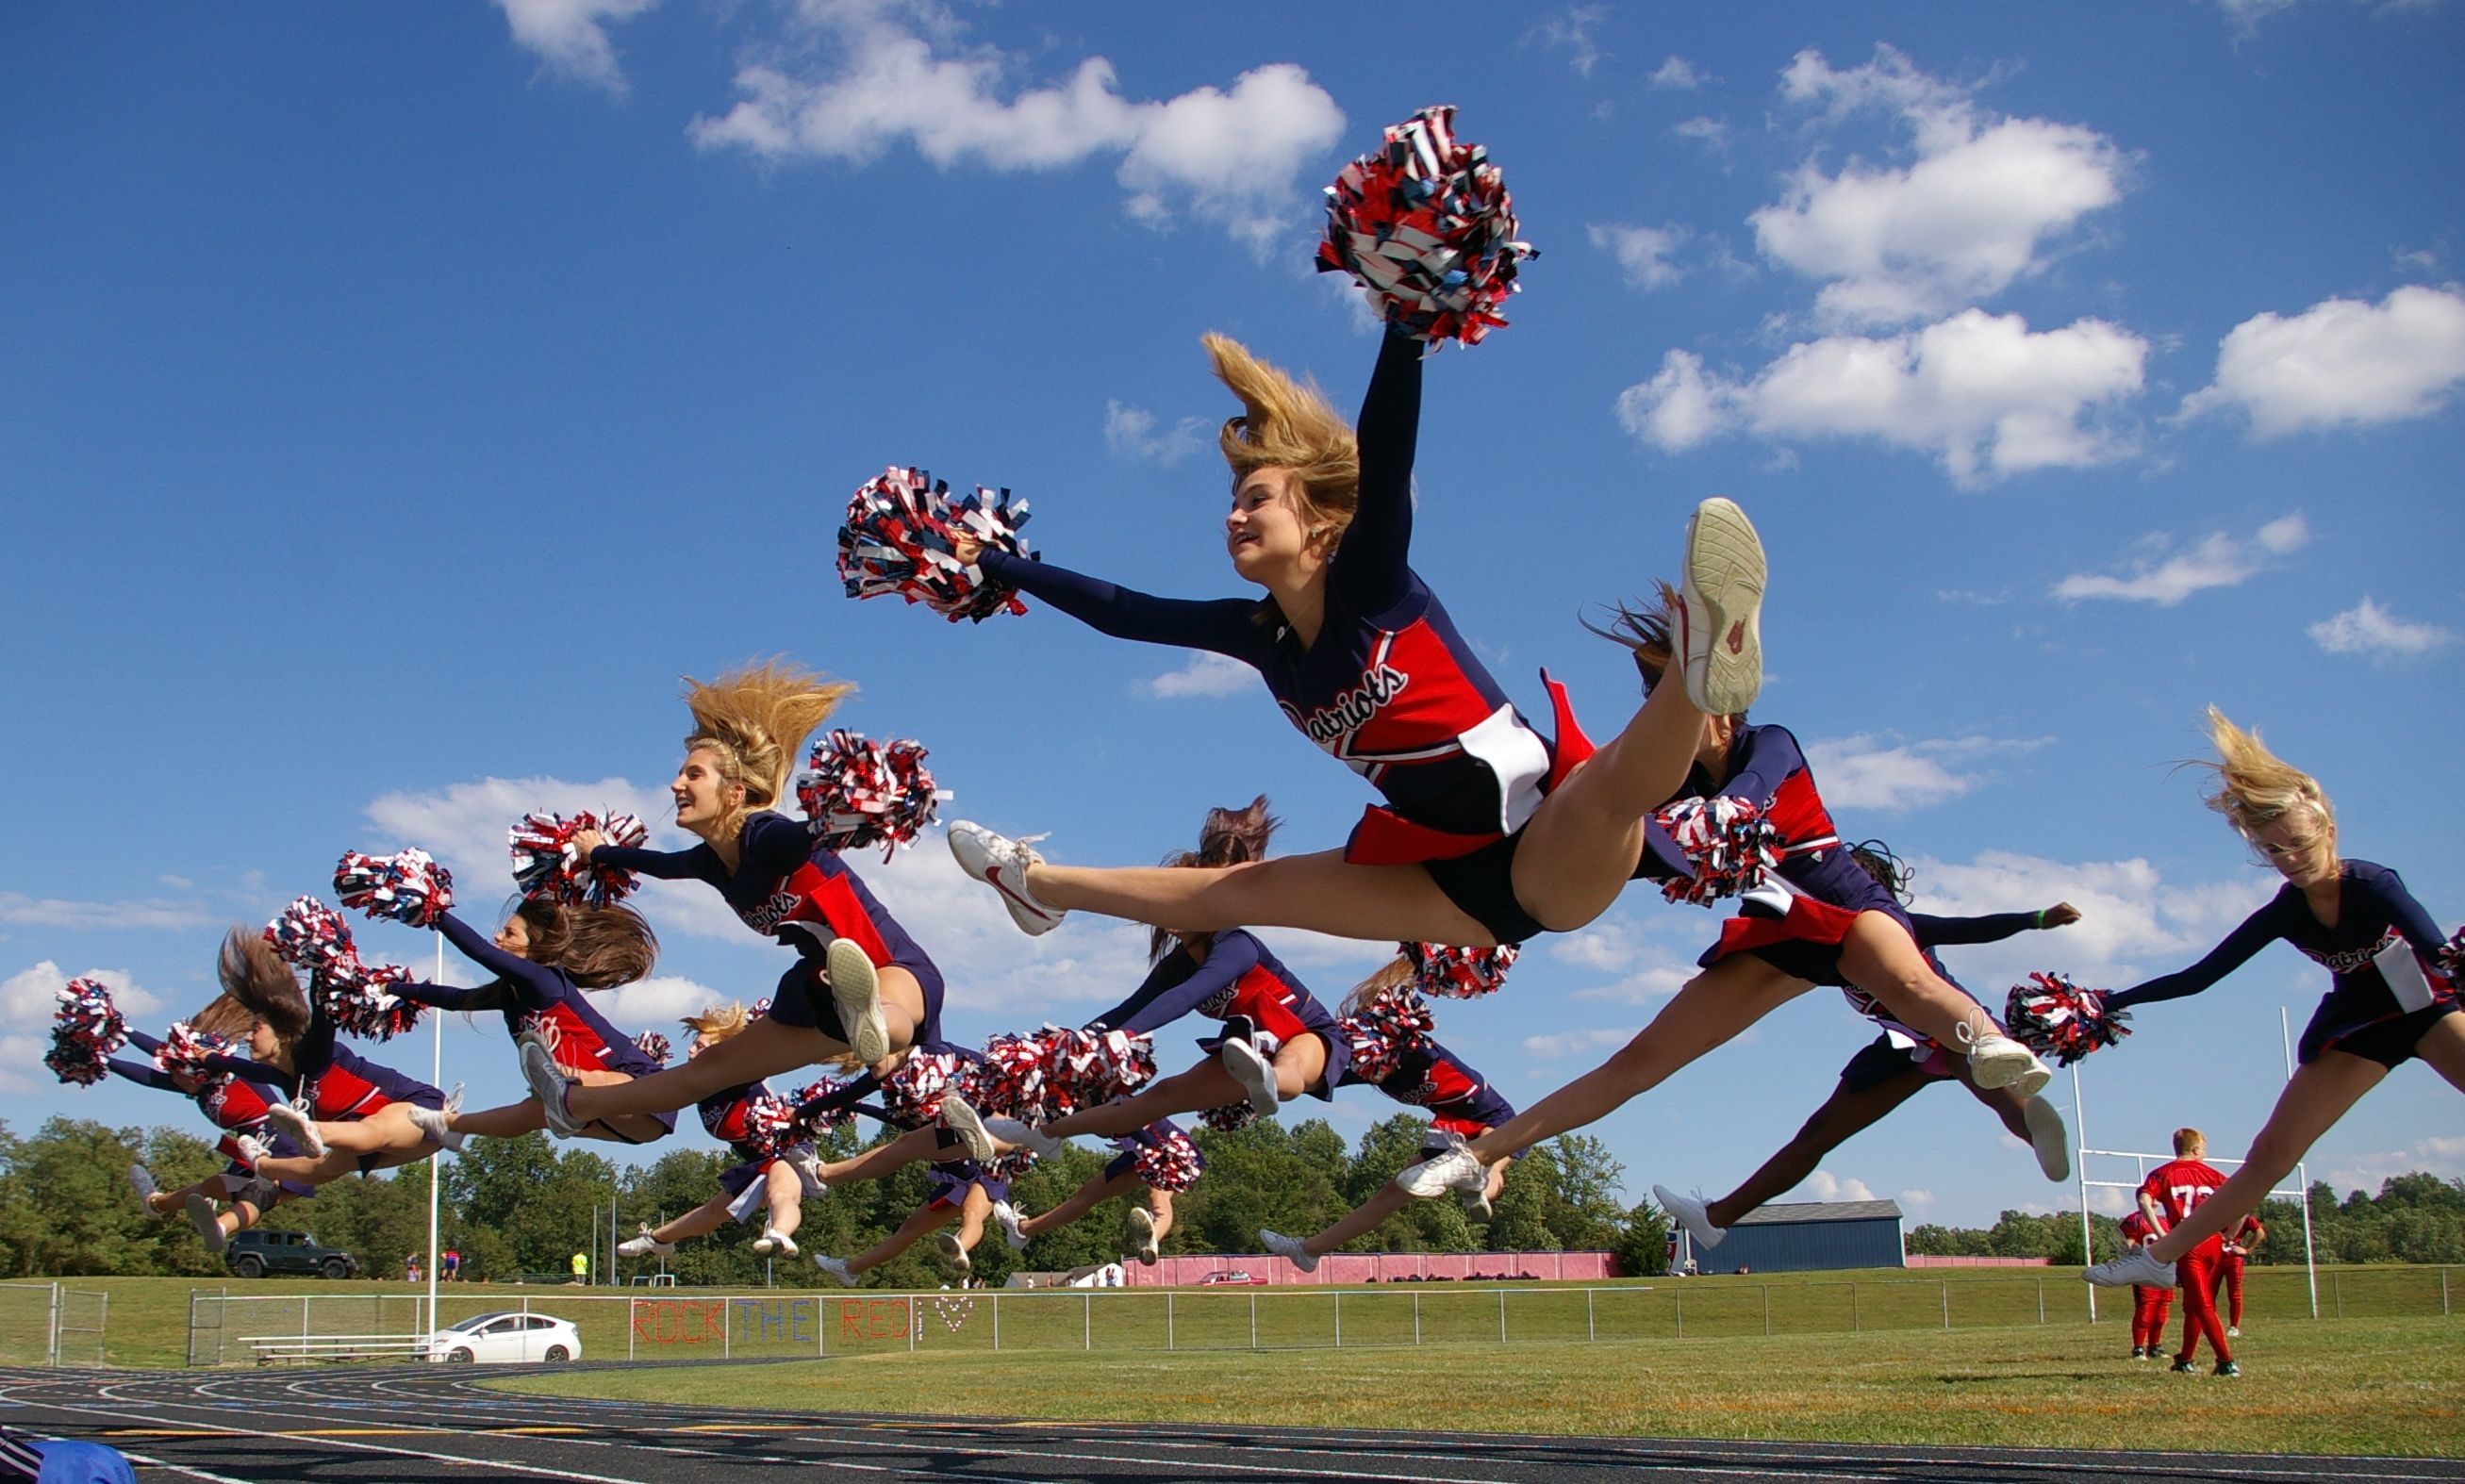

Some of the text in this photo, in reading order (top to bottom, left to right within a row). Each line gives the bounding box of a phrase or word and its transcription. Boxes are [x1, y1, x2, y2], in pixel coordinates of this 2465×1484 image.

[633, 1300, 725, 1344] ROCK
[734, 1299, 812, 1342] THE
[841, 1298, 910, 1341] RED
